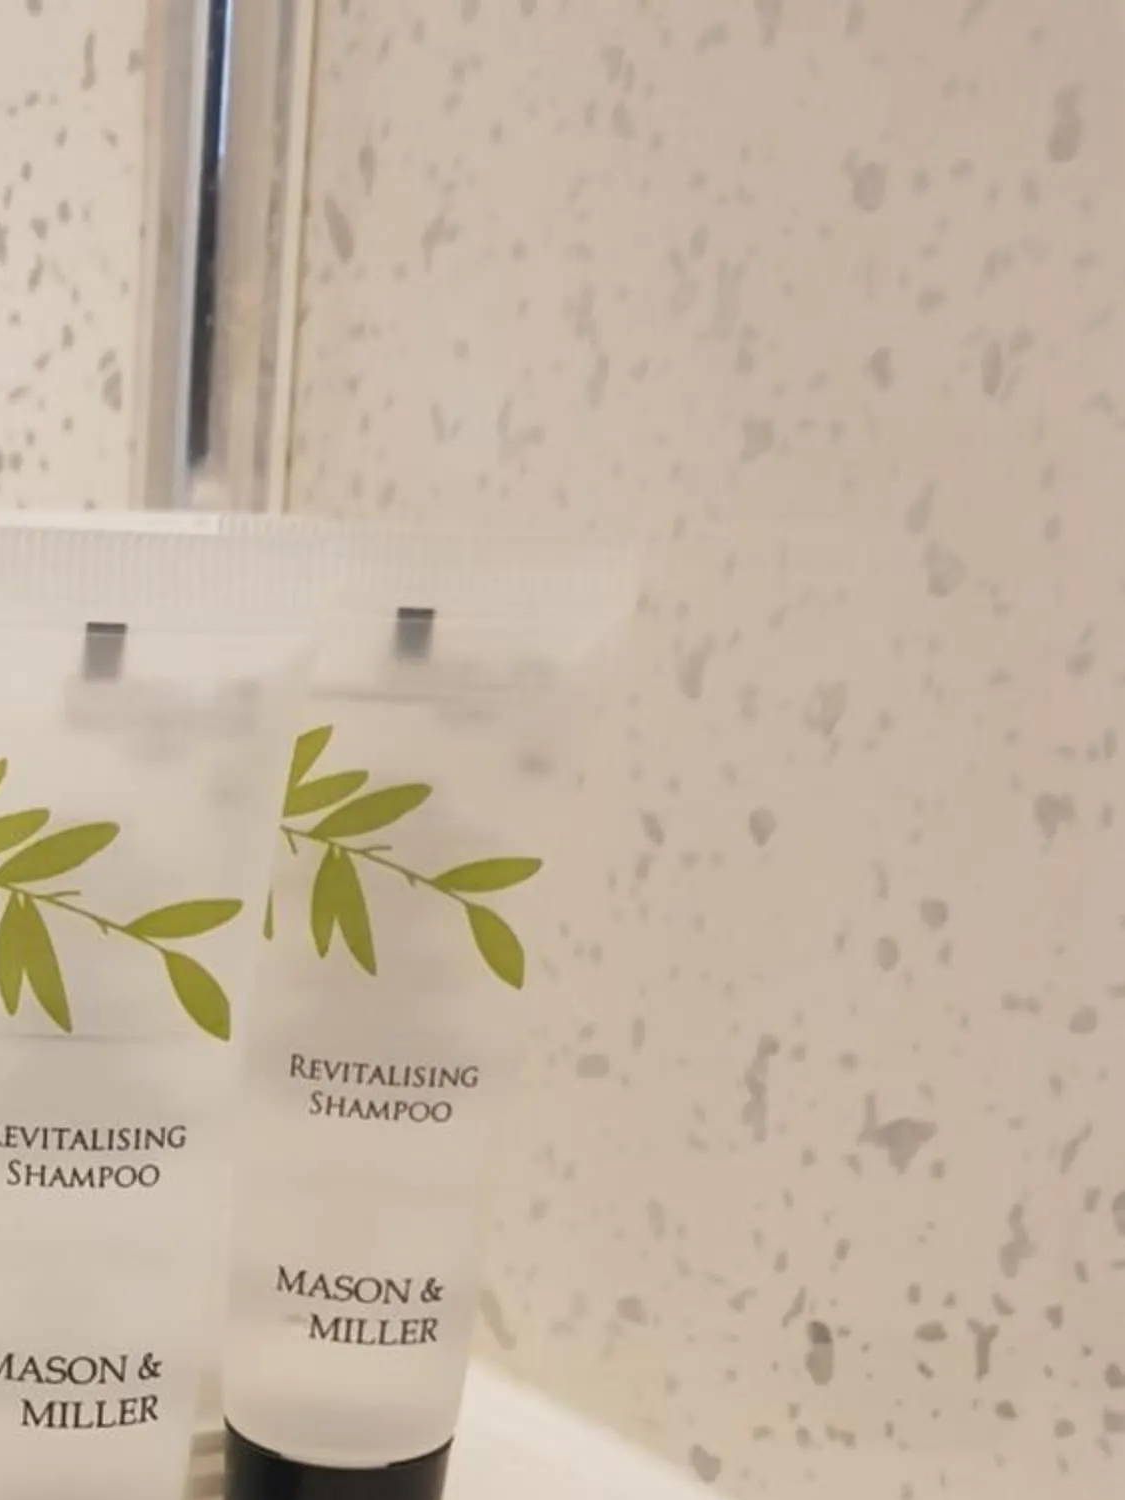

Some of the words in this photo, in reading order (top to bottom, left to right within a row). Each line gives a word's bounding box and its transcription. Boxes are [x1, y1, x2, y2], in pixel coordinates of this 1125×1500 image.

[289, 1053, 479, 1088] REVITALISING
[309, 1090, 453, 1123] SHAMPOO
[6, 1158, 161, 1189] SHAMPOO
[275, 1264, 412, 1305] MASON
[420, 1276, 445, 1304] &
[308, 1312, 440, 1347] MILLER
[137, 1352, 163, 1381] &
[20, 1394, 160, 1431] MILLER
